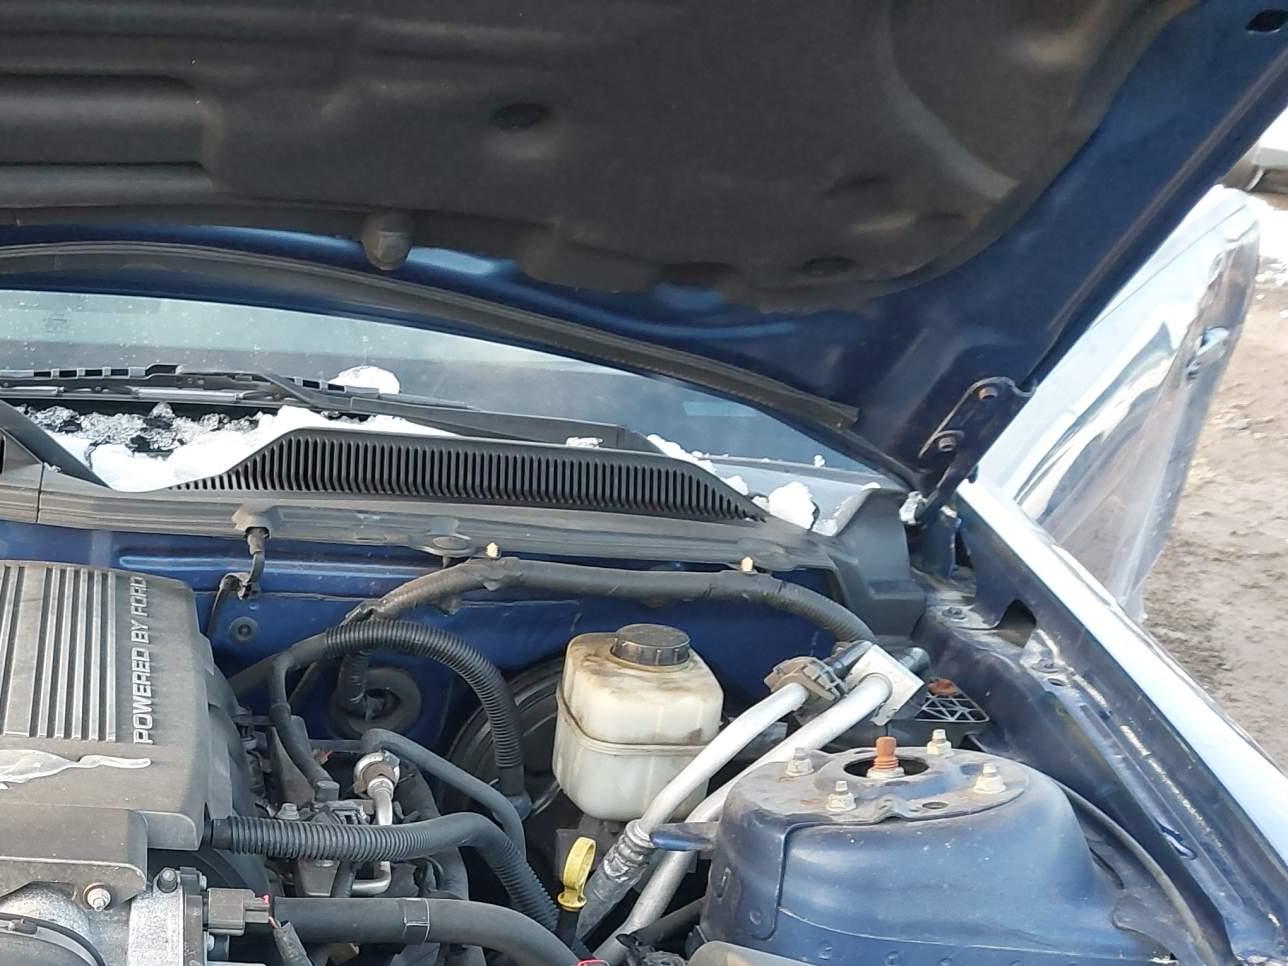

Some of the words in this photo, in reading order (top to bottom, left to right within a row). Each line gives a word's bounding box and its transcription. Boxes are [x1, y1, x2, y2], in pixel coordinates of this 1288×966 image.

[130, 576, 149, 616] FORD
[131, 619, 150, 643] BY
[132, 647, 153, 744] POWERED
